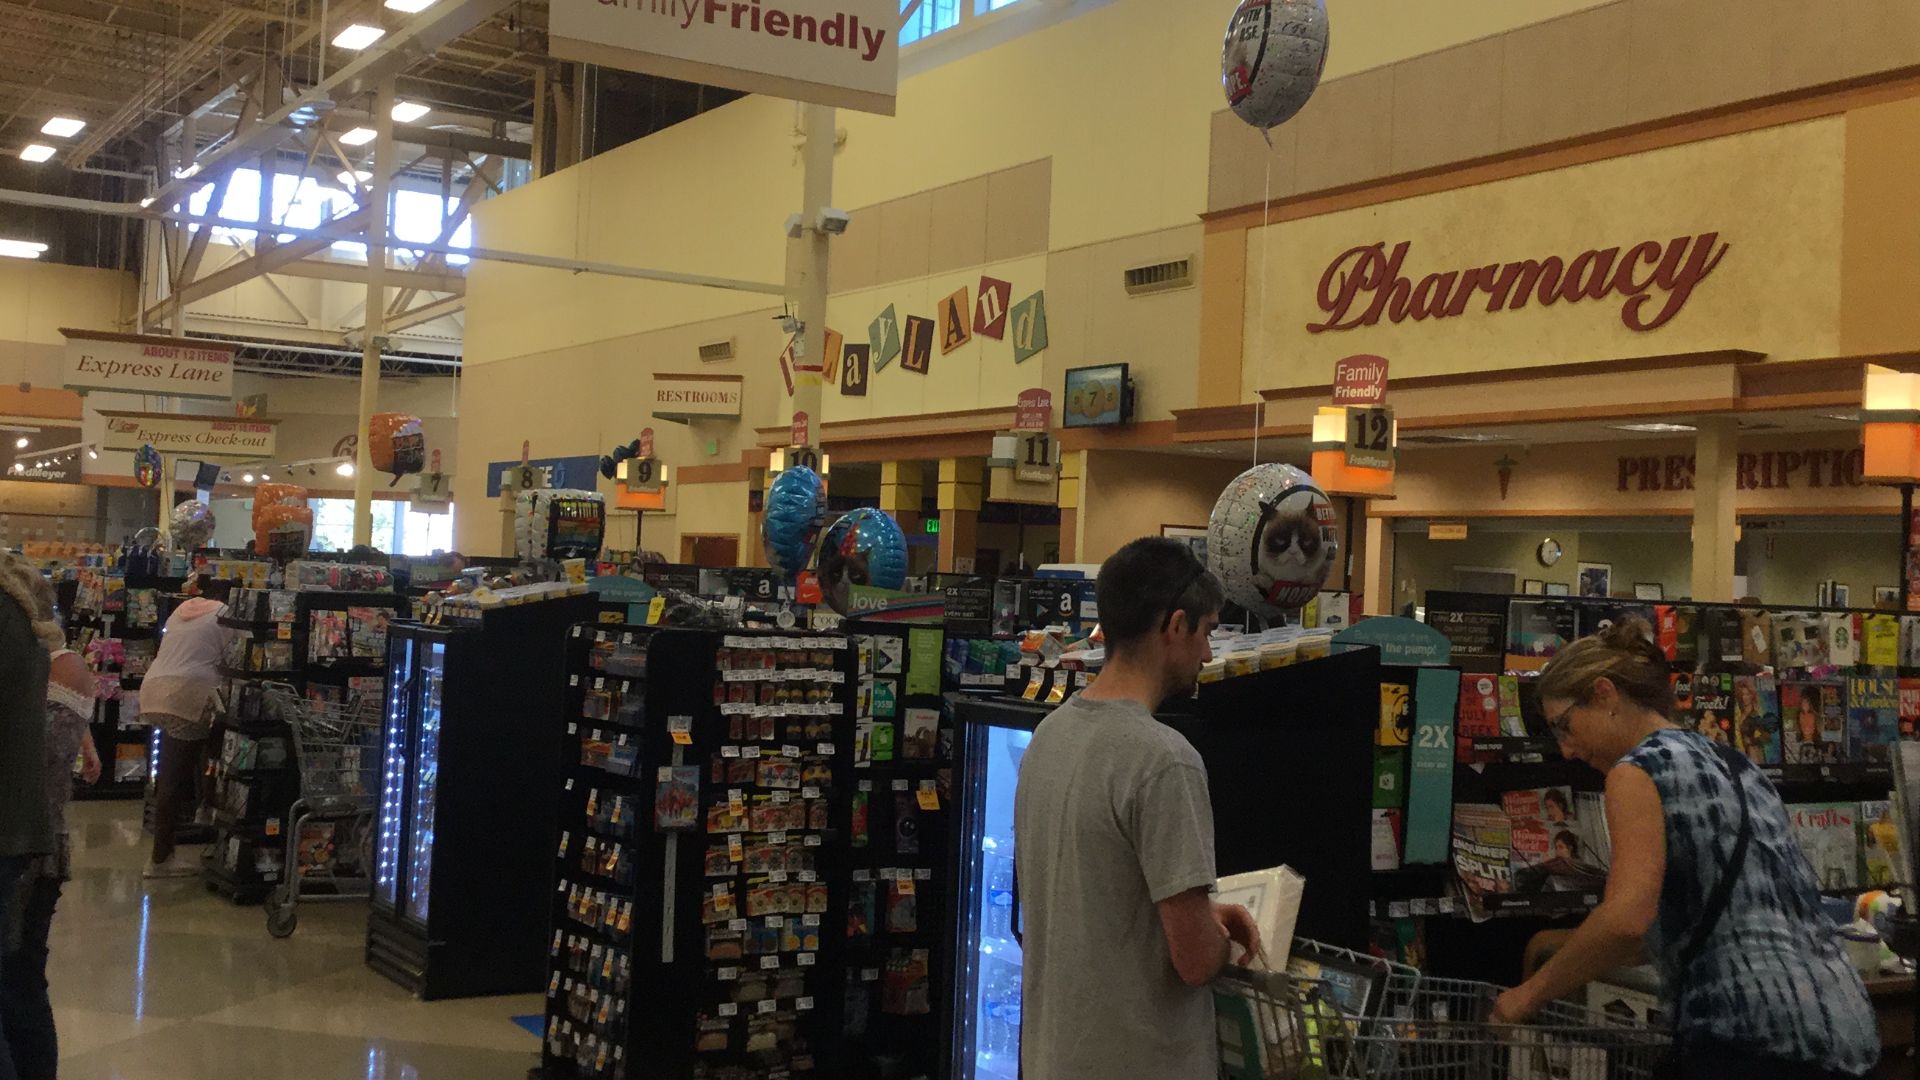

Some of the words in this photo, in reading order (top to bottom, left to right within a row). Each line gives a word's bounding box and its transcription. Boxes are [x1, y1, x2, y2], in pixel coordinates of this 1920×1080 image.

[1306, 231, 1730, 333] Pharmacy
[143, 346, 179, 360] ABOUT
[183, 349, 197, 361] 12
[198, 350, 230, 363] ITEMS
[76, 355, 163, 378] Express
[169, 362, 223, 382] Lane
[1337, 363, 1385, 384] Family
[657, 390, 738, 404] RESTROOMS
[1335, 385, 1382, 400] Friendly
[137, 430, 191, 445] Express
[195, 433, 268, 447] Check-out
[1354, 413, 1388, 451] 12
[1024, 435, 1050, 466] 11
[431, 473, 441, 492] 7
[521, 468, 534, 489] 8
[638, 462, 652, 483] 9
[852, 593, 888, 611] love
[1060, 592, 1072, 611] a
[1450, 612, 1464, 623] 2X
[1418, 725, 1450, 749] 2X
